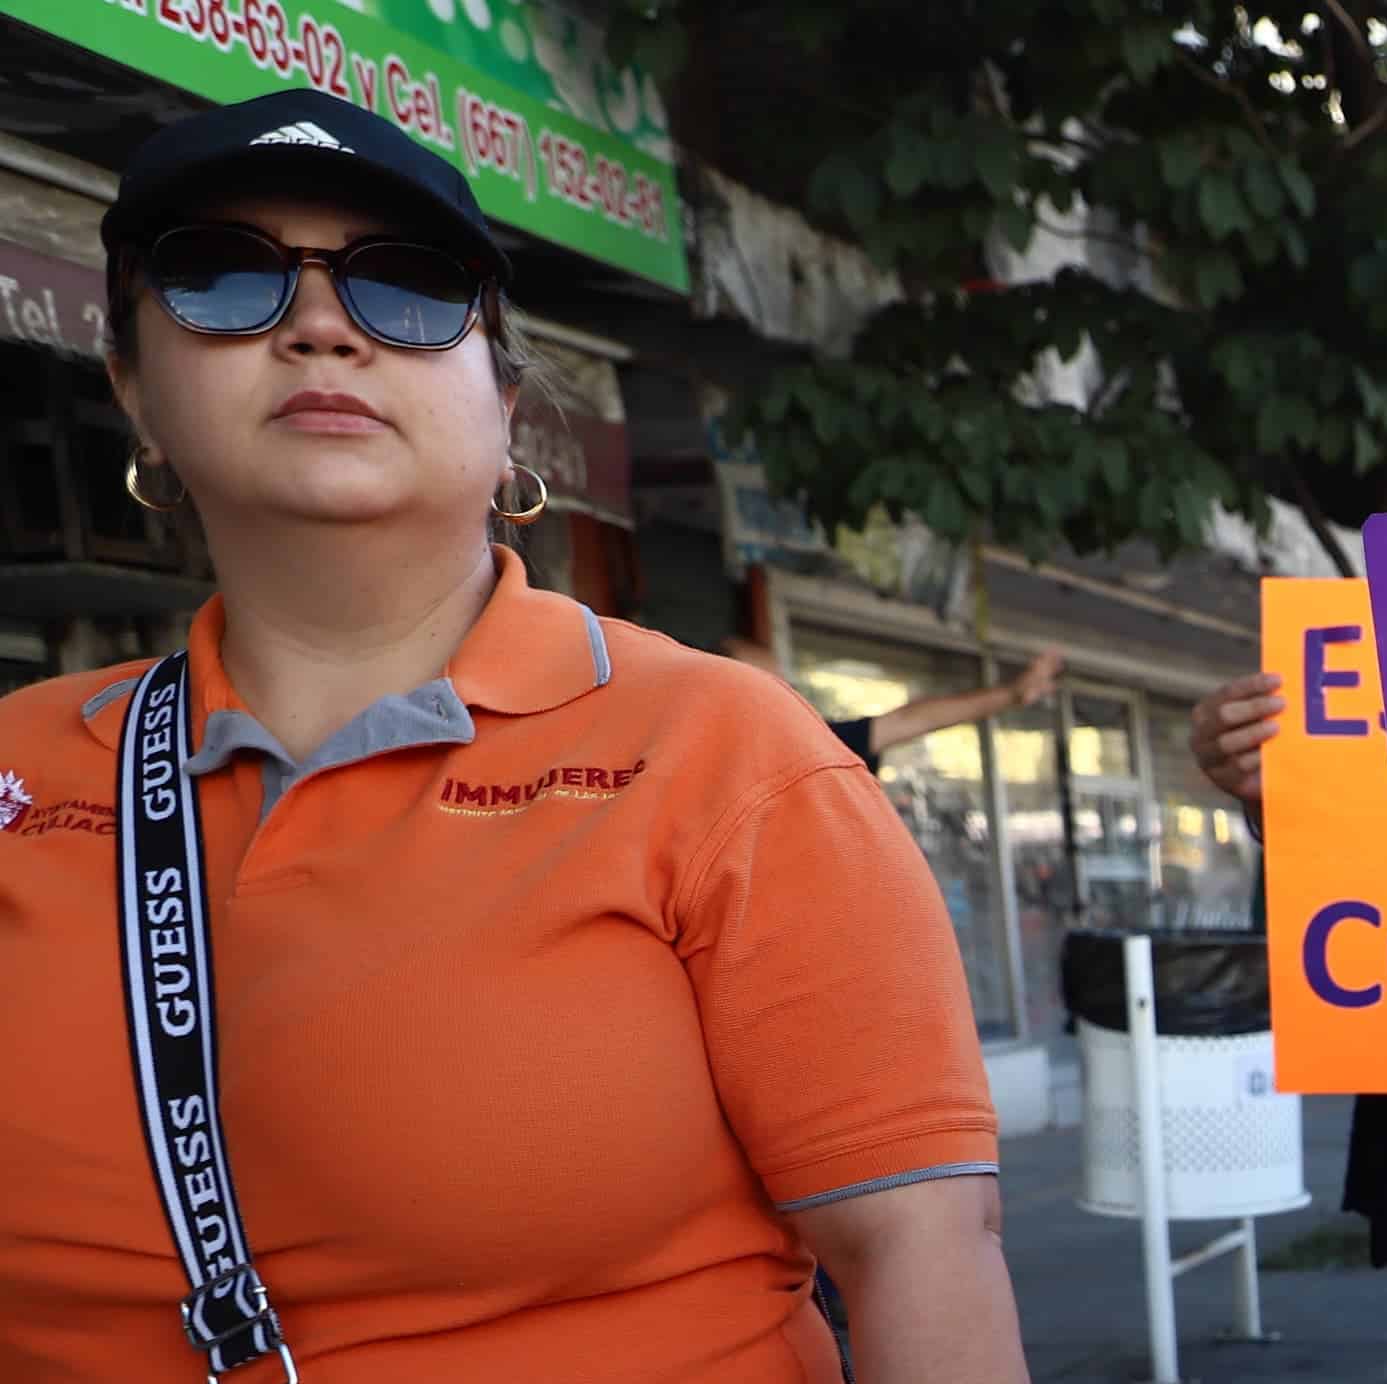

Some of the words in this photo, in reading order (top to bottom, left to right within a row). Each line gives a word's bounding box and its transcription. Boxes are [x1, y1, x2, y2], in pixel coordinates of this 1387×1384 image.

[384, 52, 454, 151] Cel.
[456, 87, 538, 203] (667)
[142, 681, 177, 822] GUESS
[145, 865, 199, 1038] GUESS
[167, 1093, 237, 1300] GUESS
